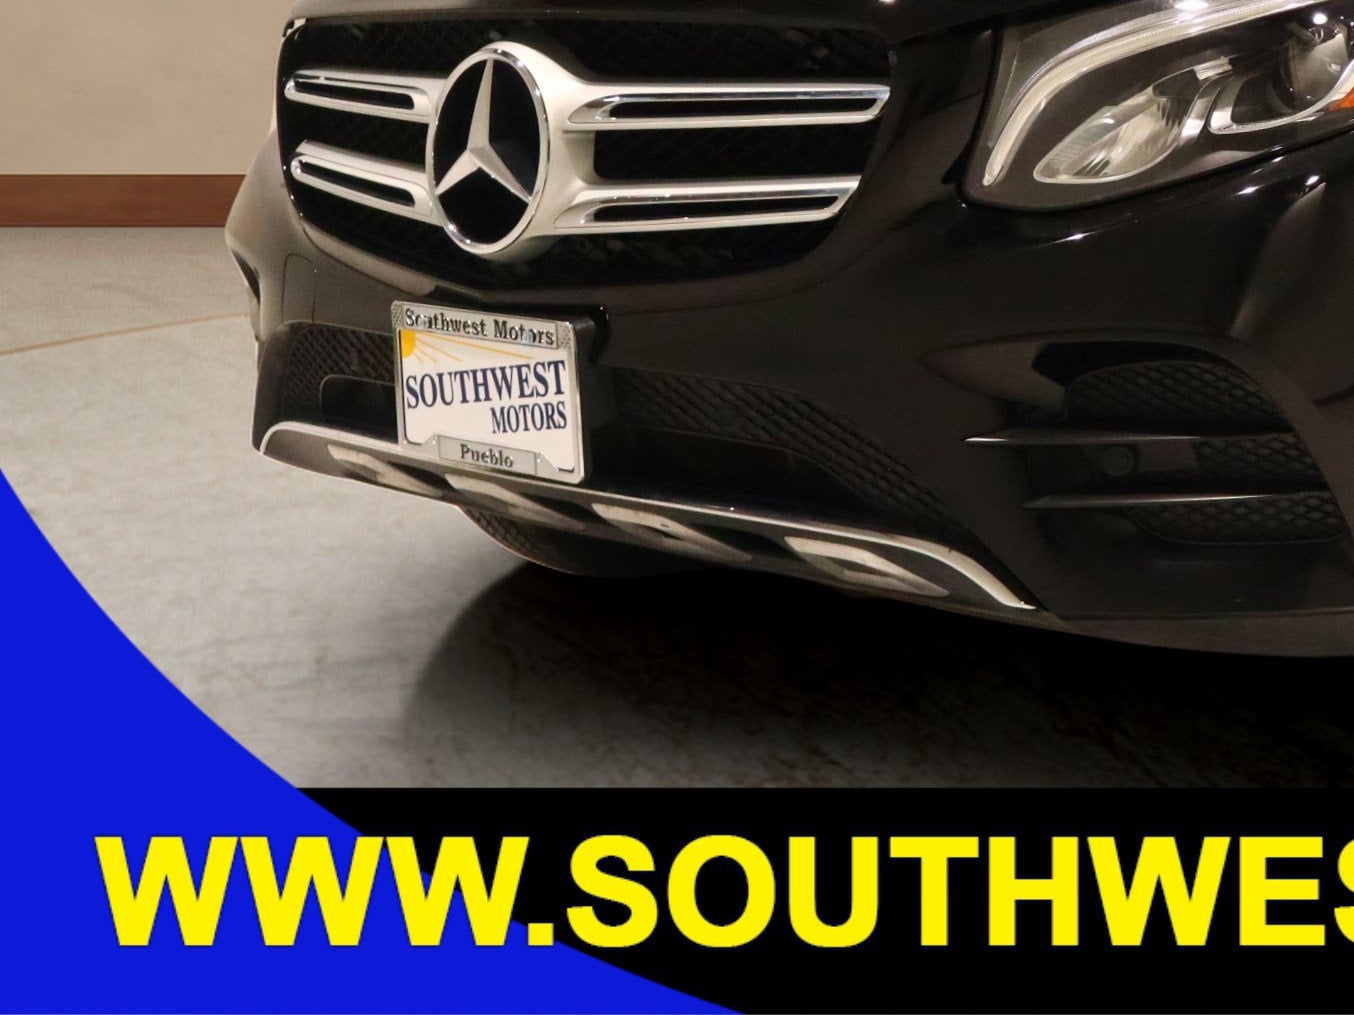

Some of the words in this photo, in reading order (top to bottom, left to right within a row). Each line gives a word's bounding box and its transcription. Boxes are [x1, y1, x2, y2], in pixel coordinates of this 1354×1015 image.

[405, 307, 487, 337] Southwest
[493, 318, 555, 345] Motors
[405, 359, 566, 409] SOUTHWEST
[490, 400, 567, 434] MOTORS
[459, 443, 514, 468] Pueblo
